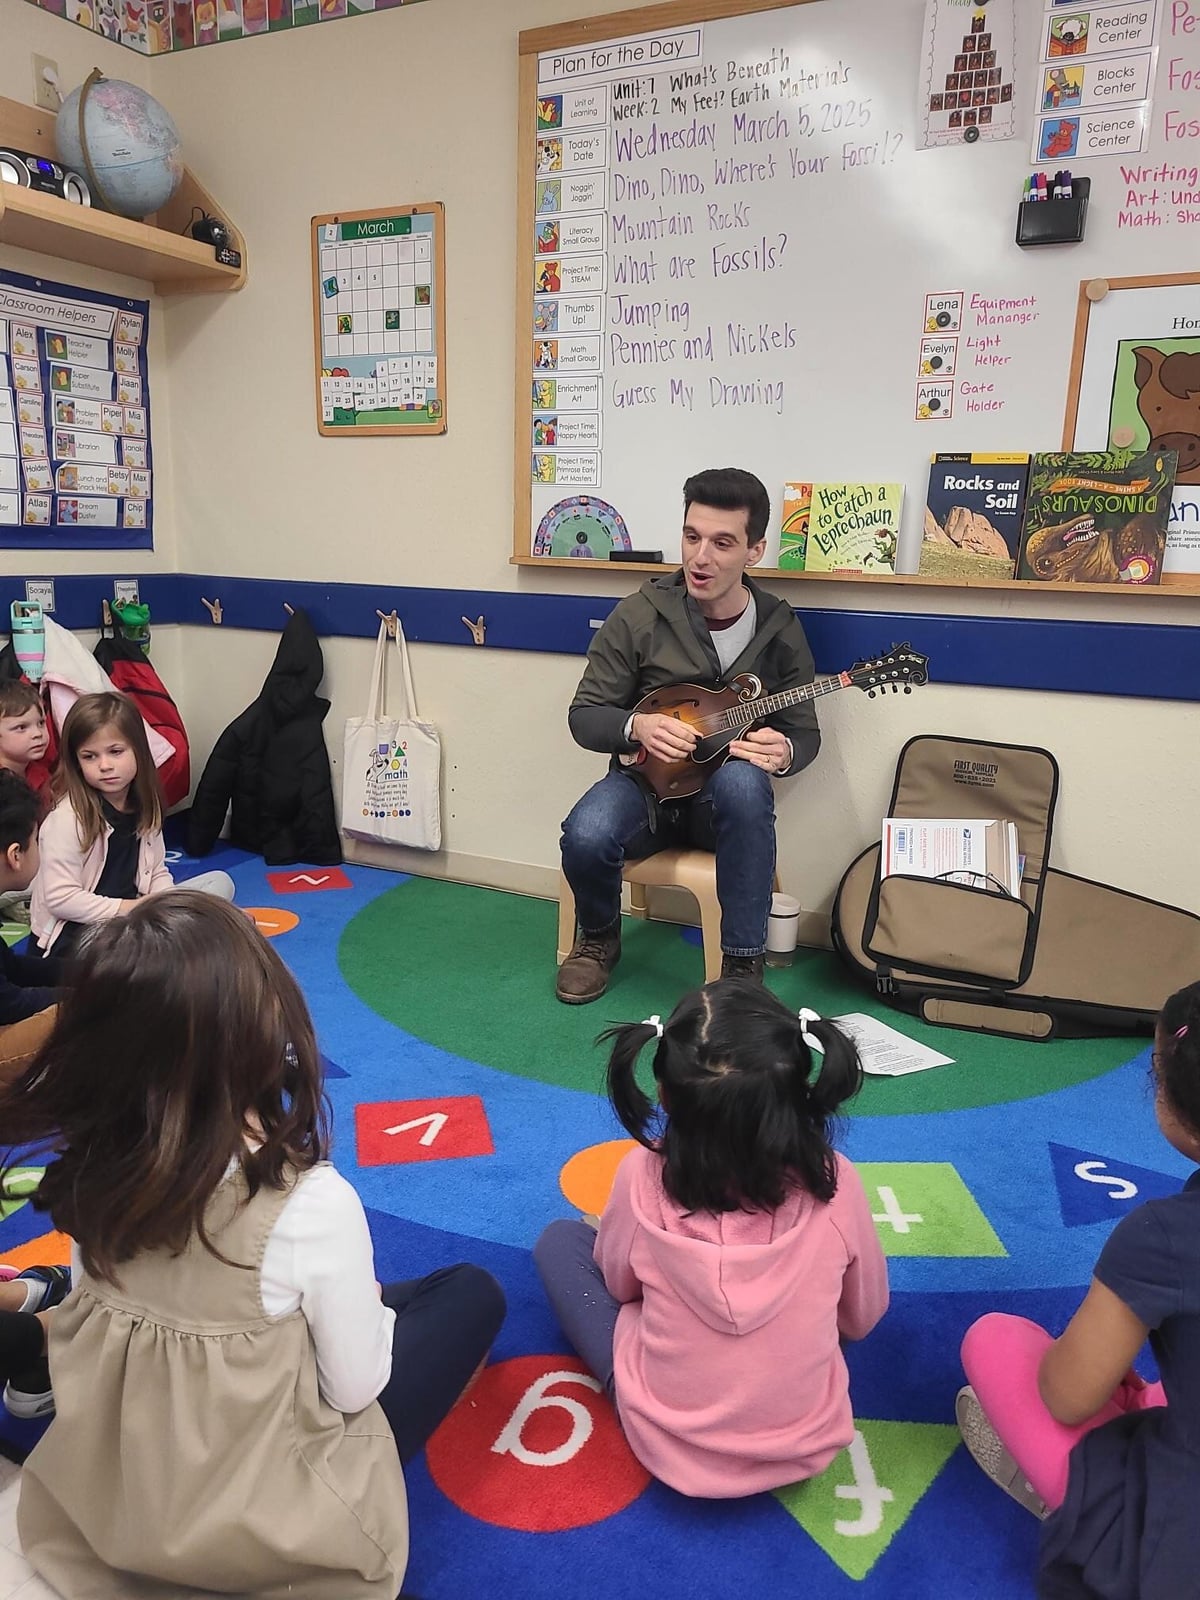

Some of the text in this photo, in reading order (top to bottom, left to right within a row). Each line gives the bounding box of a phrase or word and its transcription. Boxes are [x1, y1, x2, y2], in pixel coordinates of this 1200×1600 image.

[1095, 12, 1148, 30] Reading
[1098, 28, 1142, 44] Center
[553, 38, 685, 76] Plan for the Day
[669, 65, 718, 92] What's
[726, 47, 791, 82] Beneath
[1097, 66, 1136, 82] Blocks
[1093, 81, 1137, 96] Center
[670, 92, 688, 116] My
[692, 90, 726, 113] Feet?
[730, 86, 771, 110] Earth
[570, 106, 598, 120] Learning
[1086, 118, 1136, 135] Science
[614, 121, 717, 162] Wednesday
[733, 112, 791, 146] March
[1088, 132, 1132, 148] Center
[567, 138, 600, 152] Today's
[573, 149, 594, 161] Date
[613, 172, 656, 203] Dino,
[659, 165, 705, 196] Dino,
[713, 153, 777, 187] Where's
[788, 148, 830, 178] Your
[1120, 162, 1199, 188] Writing
[357, 219, 395, 236] March
[569, 226, 594, 237] Literacy
[612, 206, 695, 245] Mountain
[562, 235, 600, 247] Small Group
[612, 233, 788, 285] What are Fossils?
[562, 266, 581, 277] Project
[570, 274, 591, 283] STEAM
[564, 303, 595, 314] Thumbs
[930, 299, 959, 310] Lena
[970, 293, 1038, 315] Equipment
[57, 306, 97, 323] Helpers
[610, 294, 690, 332] Jumping
[120, 316, 141, 329] Rylan
[572, 315, 586, 326] Up!
[15, 327, 34, 340] Alex
[570, 345, 587, 354] Math
[609, 322, 798, 367] Pennies and Nickels
[923, 343, 955, 355] Evelyn
[966, 335, 1002, 352] Light
[116, 346, 136, 358] Molly
[560, 354, 597, 365] Small Group
[974, 354, 1013, 367] Helper
[14, 362, 38, 372] Carson
[557, 383, 597, 393] Enrichment
[918, 387, 952, 399] Arthur
[959, 381, 995, 395] Gate
[571, 394, 582, 403] Art
[611, 376, 785, 415] Guess My Drawing
[103, 407, 122, 418] Piper
[966, 400, 1006, 413] Holder
[128, 410, 141, 420] Mia
[558, 423, 579, 432] Project
[557, 431, 577, 440] Happy
[558, 457, 578, 466] Project
[26, 464, 48, 473] Holden
[557, 466, 581, 474] Primrose
[109, 470, 130, 482] Betsy
[132, 473, 147, 482] Max
[570, 475, 592, 483] Masters
[944, 475, 1020, 491] Rocks and
[27, 498, 49, 509] Atlas
[817, 485, 847, 510] How
[833, 485, 887, 519] Catch a
[984, 493, 1018, 509] Soil
[1041, 494, 1159, 514] DINOSAURS
[127, 503, 143, 513] Chip
[818, 513, 832, 529] to
[812, 508, 895, 556] Leprechaun
[954, 760, 971, 771] FIRST
[971, 762, 999, 775] QUALITY
[384, 769, 408, 780] math
